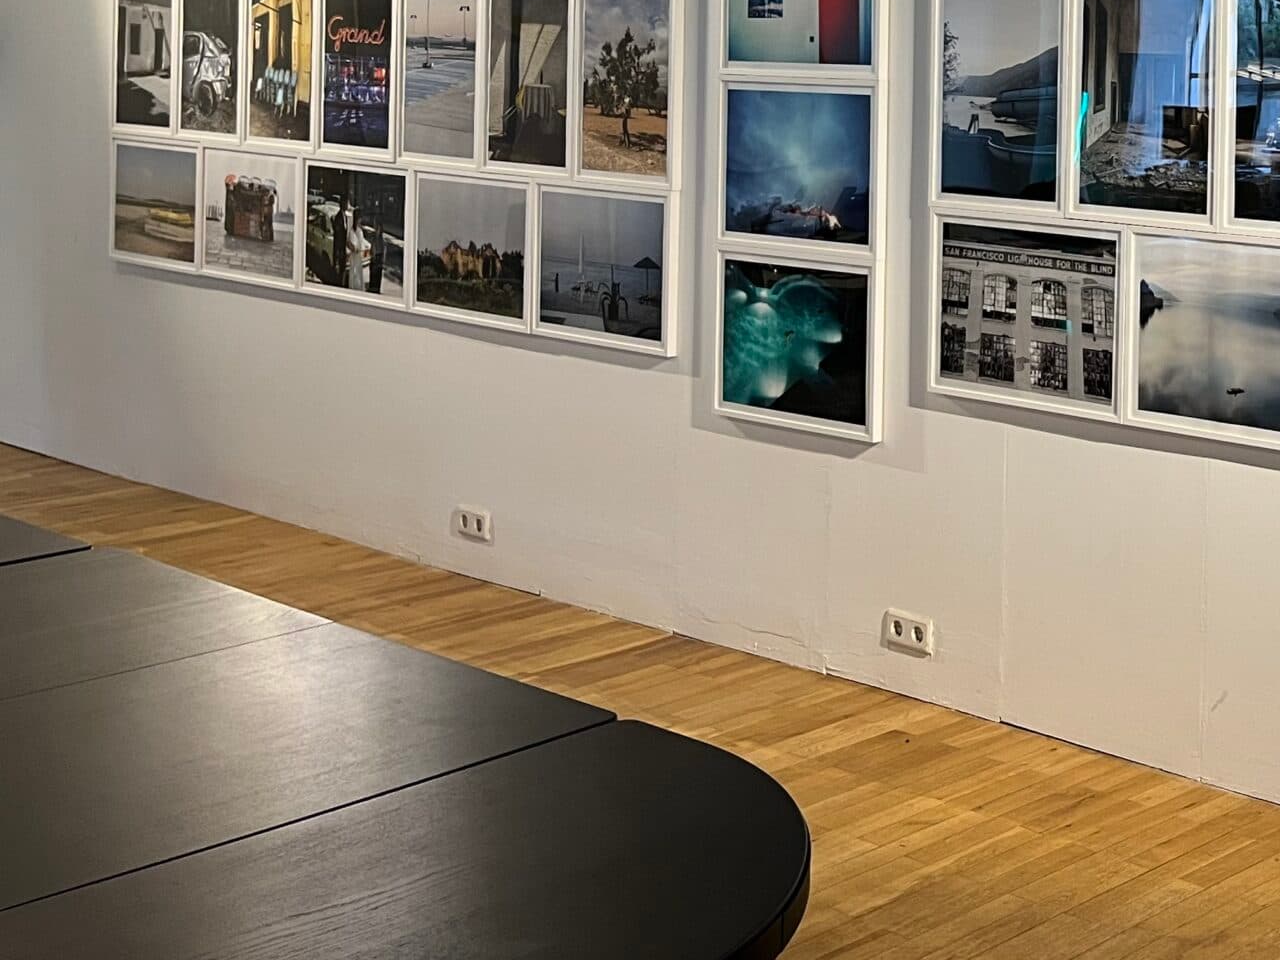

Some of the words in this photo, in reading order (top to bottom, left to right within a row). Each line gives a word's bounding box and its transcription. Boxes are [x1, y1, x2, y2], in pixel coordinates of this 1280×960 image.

[327, 16, 386, 52] Grand
[944, 247, 960, 257] SAN
[962, 248, 1005, 262] FRANCISCO
[1056, 259, 1072, 270] FOR
[1074, 261, 1088, 272] THE
[1090, 263, 1113, 275] BLIND
